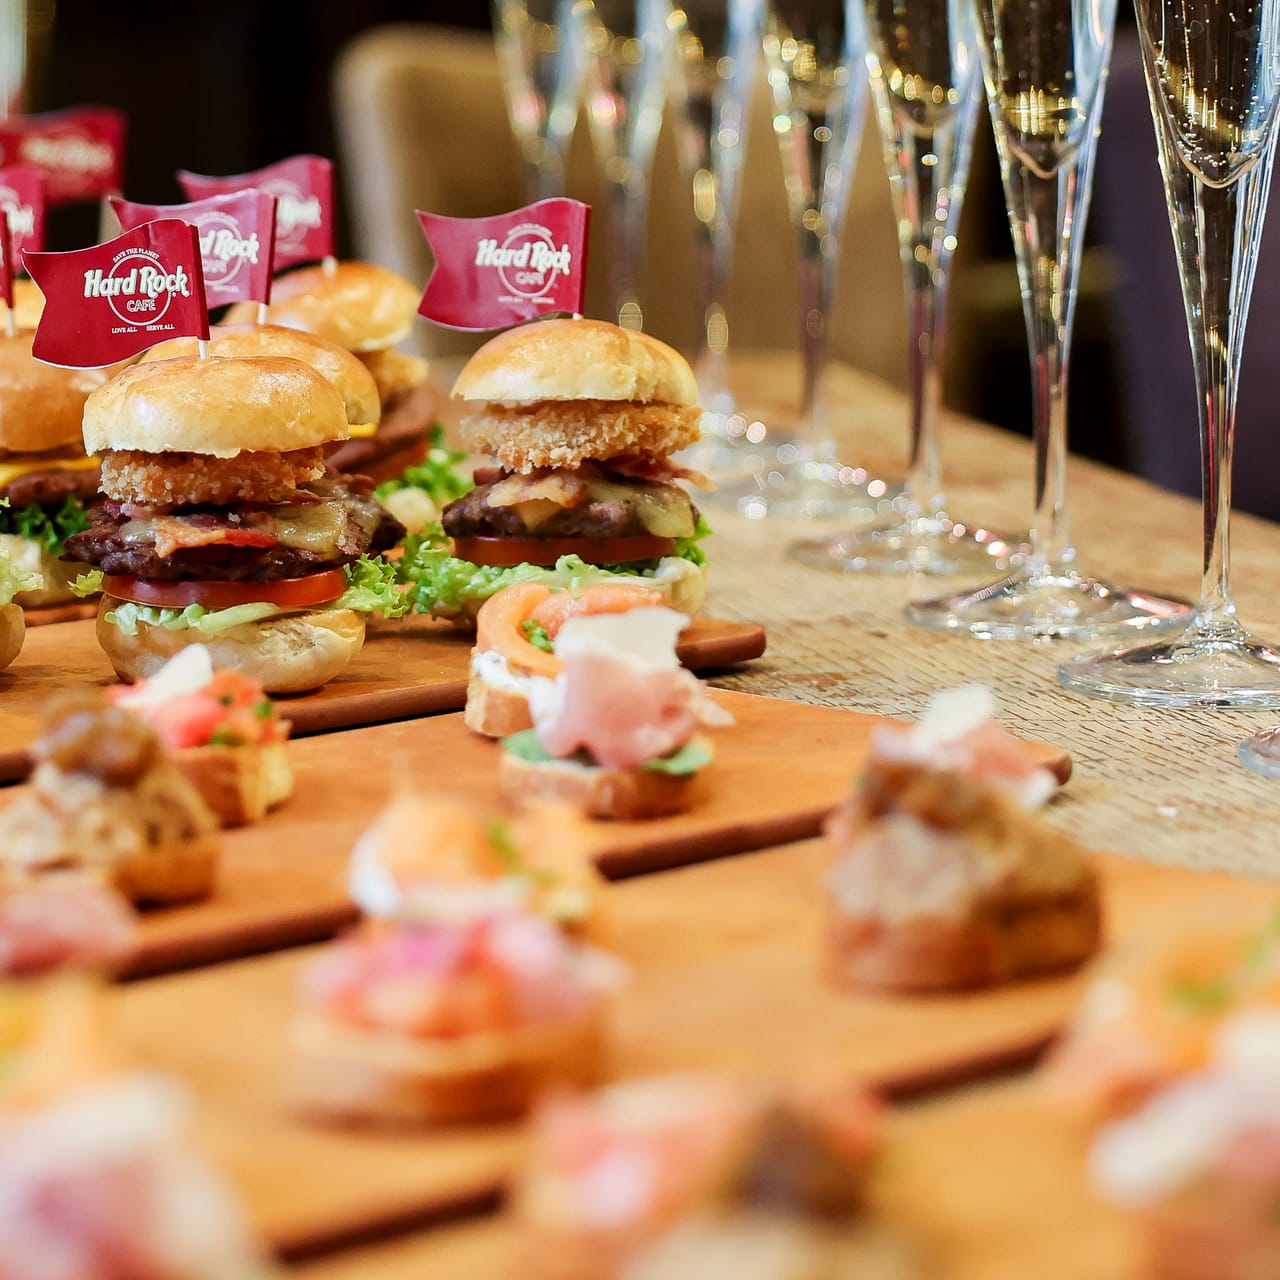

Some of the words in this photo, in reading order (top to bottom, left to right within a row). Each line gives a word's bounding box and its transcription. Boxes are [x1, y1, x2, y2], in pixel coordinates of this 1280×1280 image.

[112, 250, 125, 263] SAVE
[138, 248, 161, 261] PLANET
[213, 229, 260, 265] Rock
[475, 239, 532, 268] Hard
[529, 241, 572, 276] Rock
[83, 268, 138, 298] Hard
[138, 265, 190, 299] Rock
[126, 299, 157, 313] CAFE
